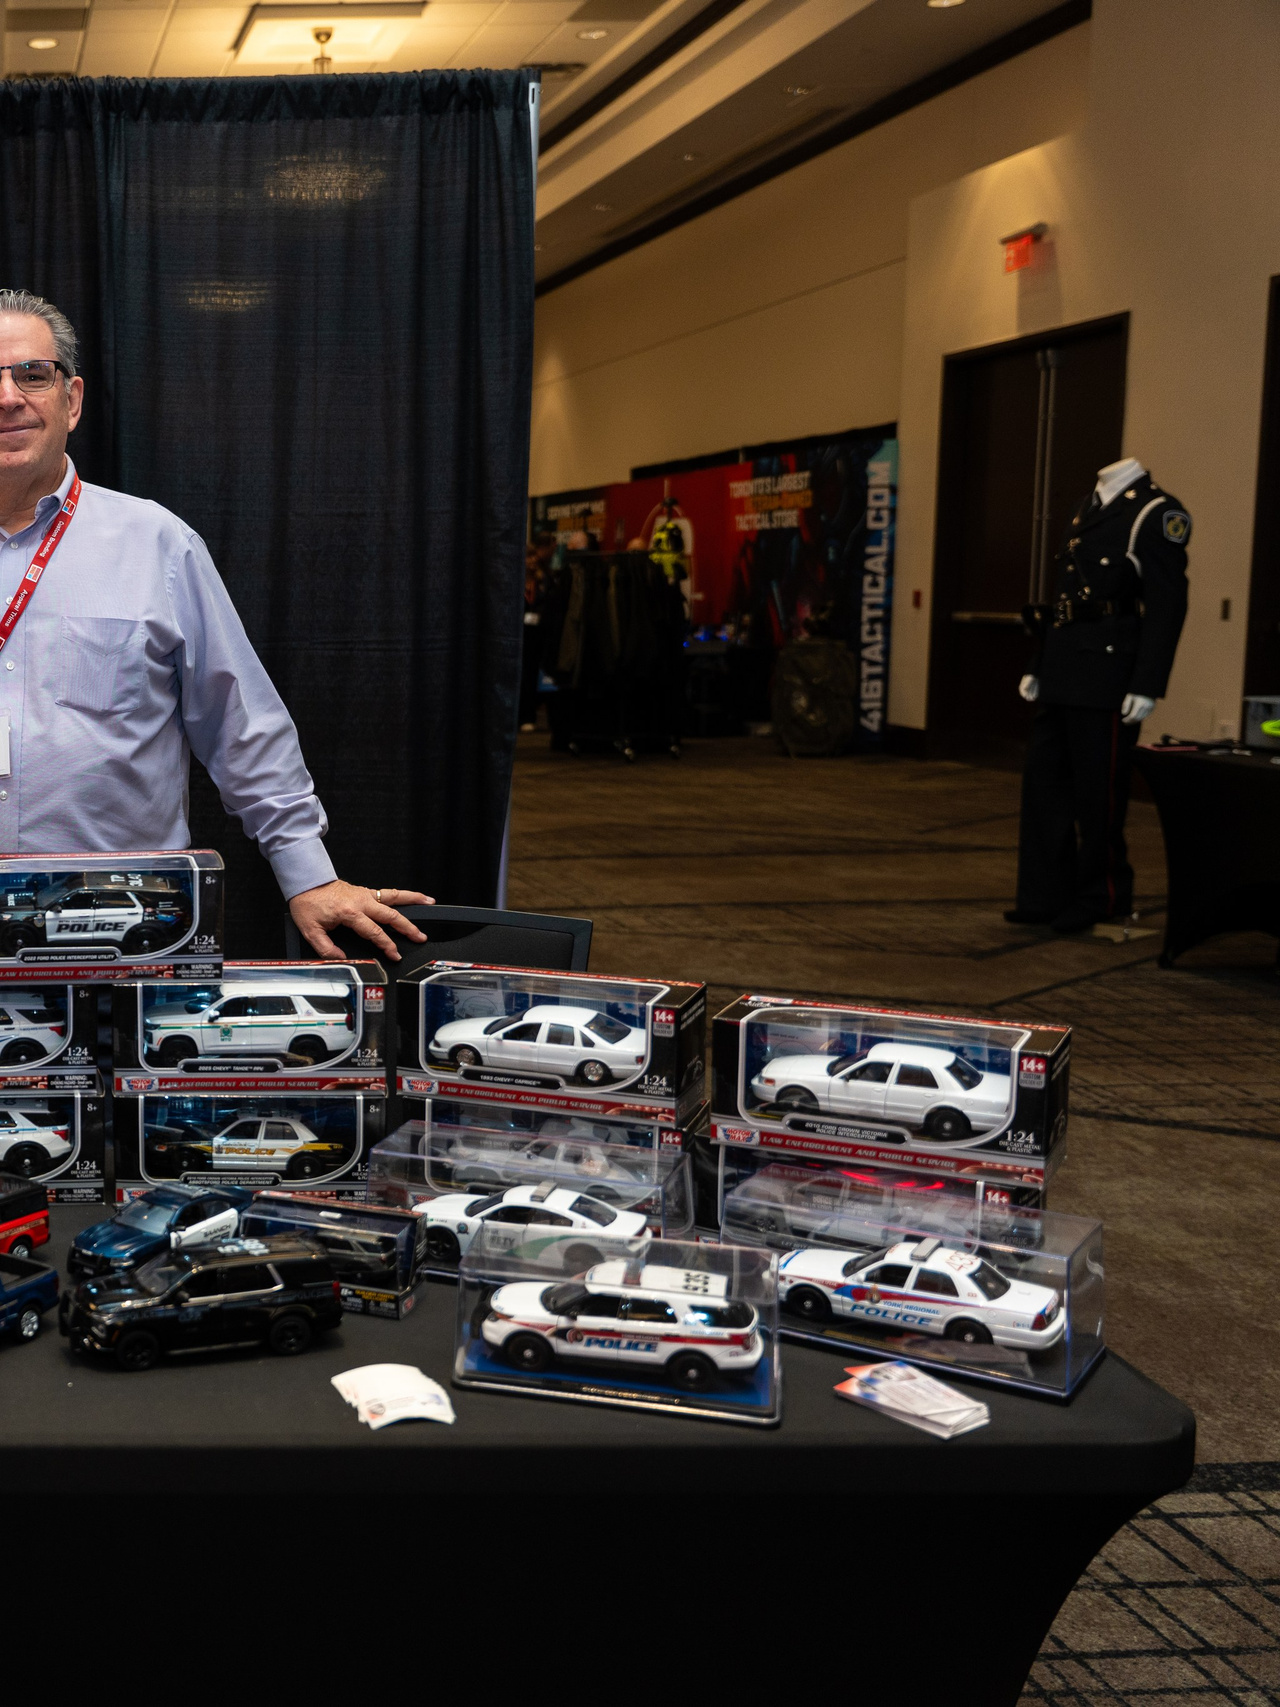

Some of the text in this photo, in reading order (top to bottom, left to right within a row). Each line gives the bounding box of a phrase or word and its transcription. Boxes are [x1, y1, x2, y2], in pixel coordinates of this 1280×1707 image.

[39, 520, 65, 558] Custom Branding
[860, 460, 892, 733] 416TACTICAL.COM
[4, 589, 29, 627] Apparel Trims
[205, 876, 216, 885] 8+
[56, 922, 126, 934] POLICE
[193, 935, 215, 945] 1:24
[79, 990, 90, 998] 8+
[365, 989, 382, 998] 14+
[654, 1010, 674, 1022] 14+
[67, 1047, 88, 1056] 1:24
[356, 1048, 378, 1058] 1:24
[1021, 1059, 1045, 1071] 14+
[642, 1074, 668, 1086] 1:24
[460, 1087, 518, 1100] ENFORCEMENT
[519, 1094, 536, 1102] AND
[538, 1097, 568, 1106] PUBLIC
[569, 1101, 604, 1110] SERVICE
[87, 1103, 98, 1112] 8+
[369, 1105, 380, 1113] 8+
[661, 1132, 681, 1144] 14+
[726, 1128, 751, 1136] MOTOR
[1005, 1130, 1035, 1144] 1:24
[223, 1148, 276, 1156] POLICE
[762, 1136, 956, 1168] LAW ENFORCEMENT AND PUBLIC SERVICE
[75, 1161, 96, 1170] 1:24
[986, 1191, 1009, 1203] 14+
[883, 1300, 940, 1315] YORK REGIONAL
[850, 1304, 932, 1326] POLICE
[583, 1337, 659, 1353] POLICE
